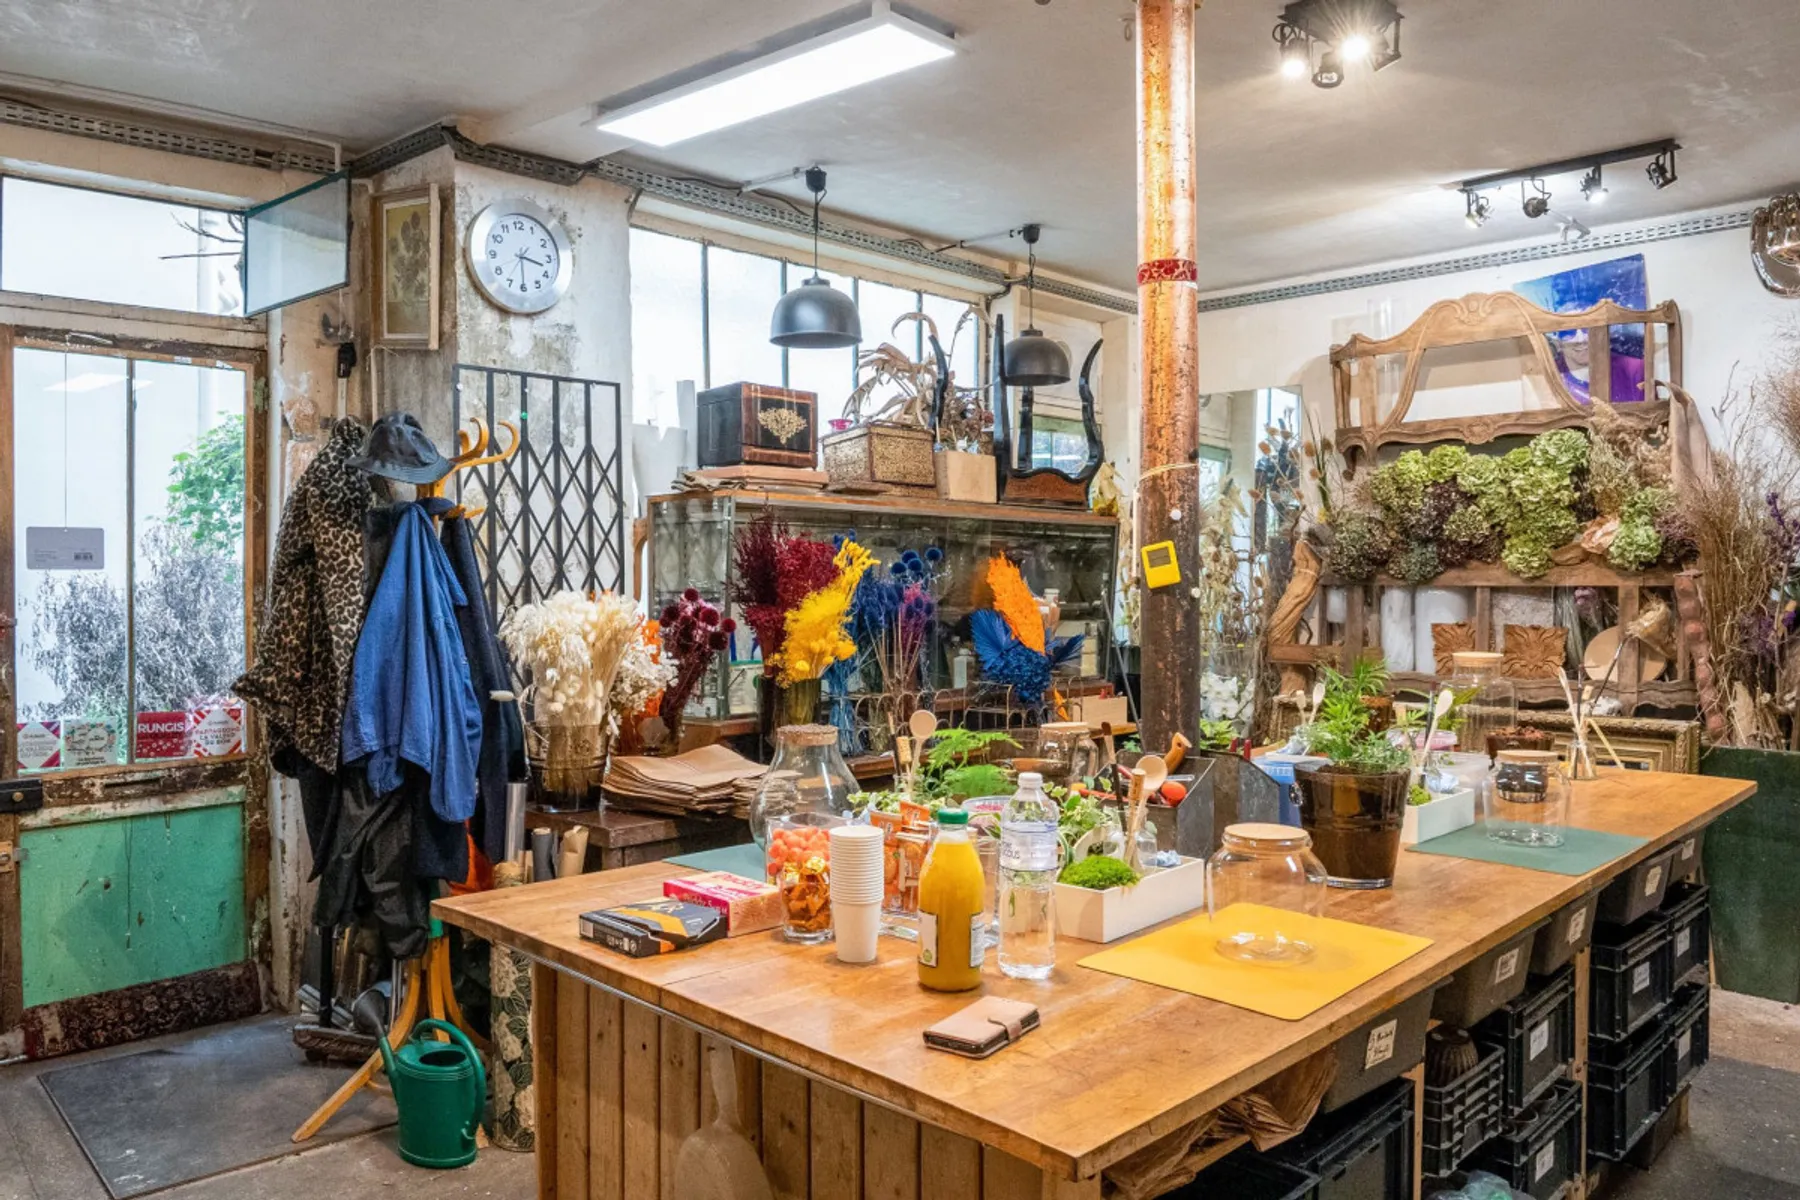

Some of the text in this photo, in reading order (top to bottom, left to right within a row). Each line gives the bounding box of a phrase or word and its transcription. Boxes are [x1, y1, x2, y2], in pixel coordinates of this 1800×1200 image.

[501, 224, 509, 233] 11
[513, 221, 524, 231] 12
[530, 226, 534, 234] 1
[492, 234, 503, 244] 10
[540, 239, 547, 248] 2
[489, 250, 497, 259] 9
[545, 254, 552, 263] 3
[495, 266, 503, 275] 8
[542, 271, 549, 279] 4
[506, 279, 513, 288] 7
[520, 283, 527, 292] 6
[535, 281, 541, 289] 5
[138, 722, 185, 733] RUNGIS
